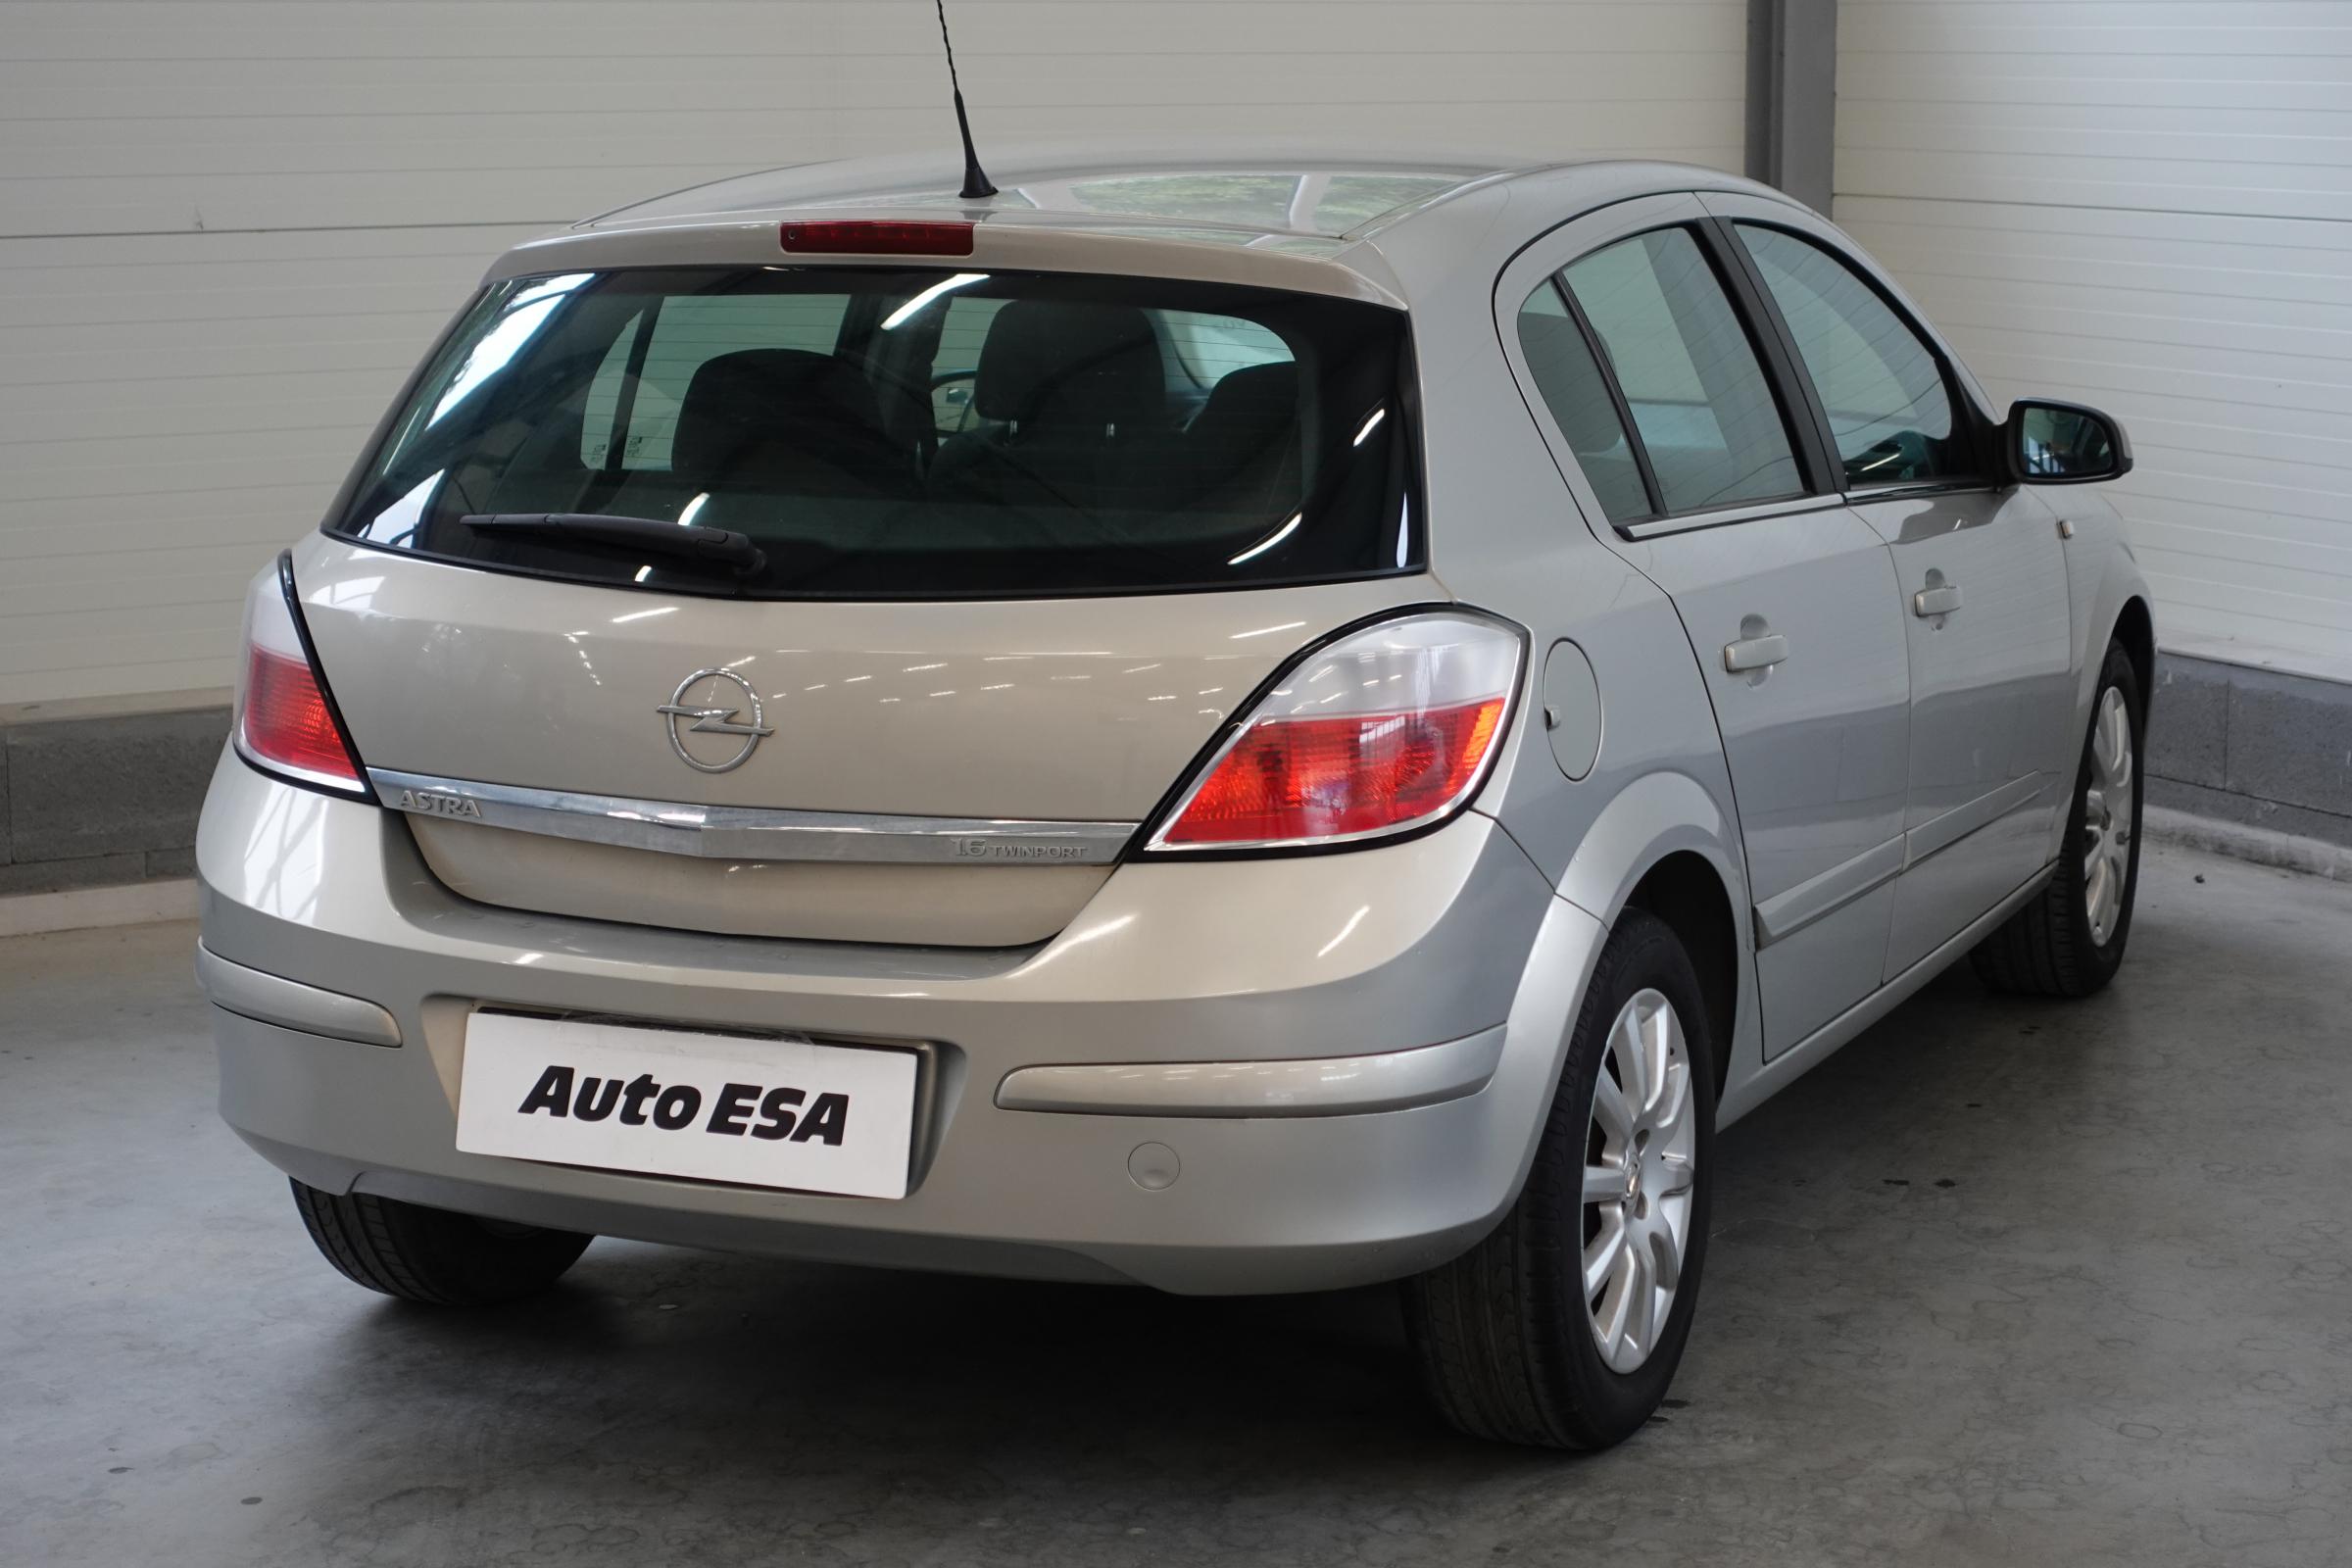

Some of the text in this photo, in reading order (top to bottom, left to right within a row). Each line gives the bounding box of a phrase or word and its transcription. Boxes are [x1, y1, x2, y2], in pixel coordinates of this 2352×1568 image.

[400, 790, 481, 817] ASTRA
[989, 844, 1089, 858] TWINPORT
[517, 1065, 850, 1147] Auto ESA
